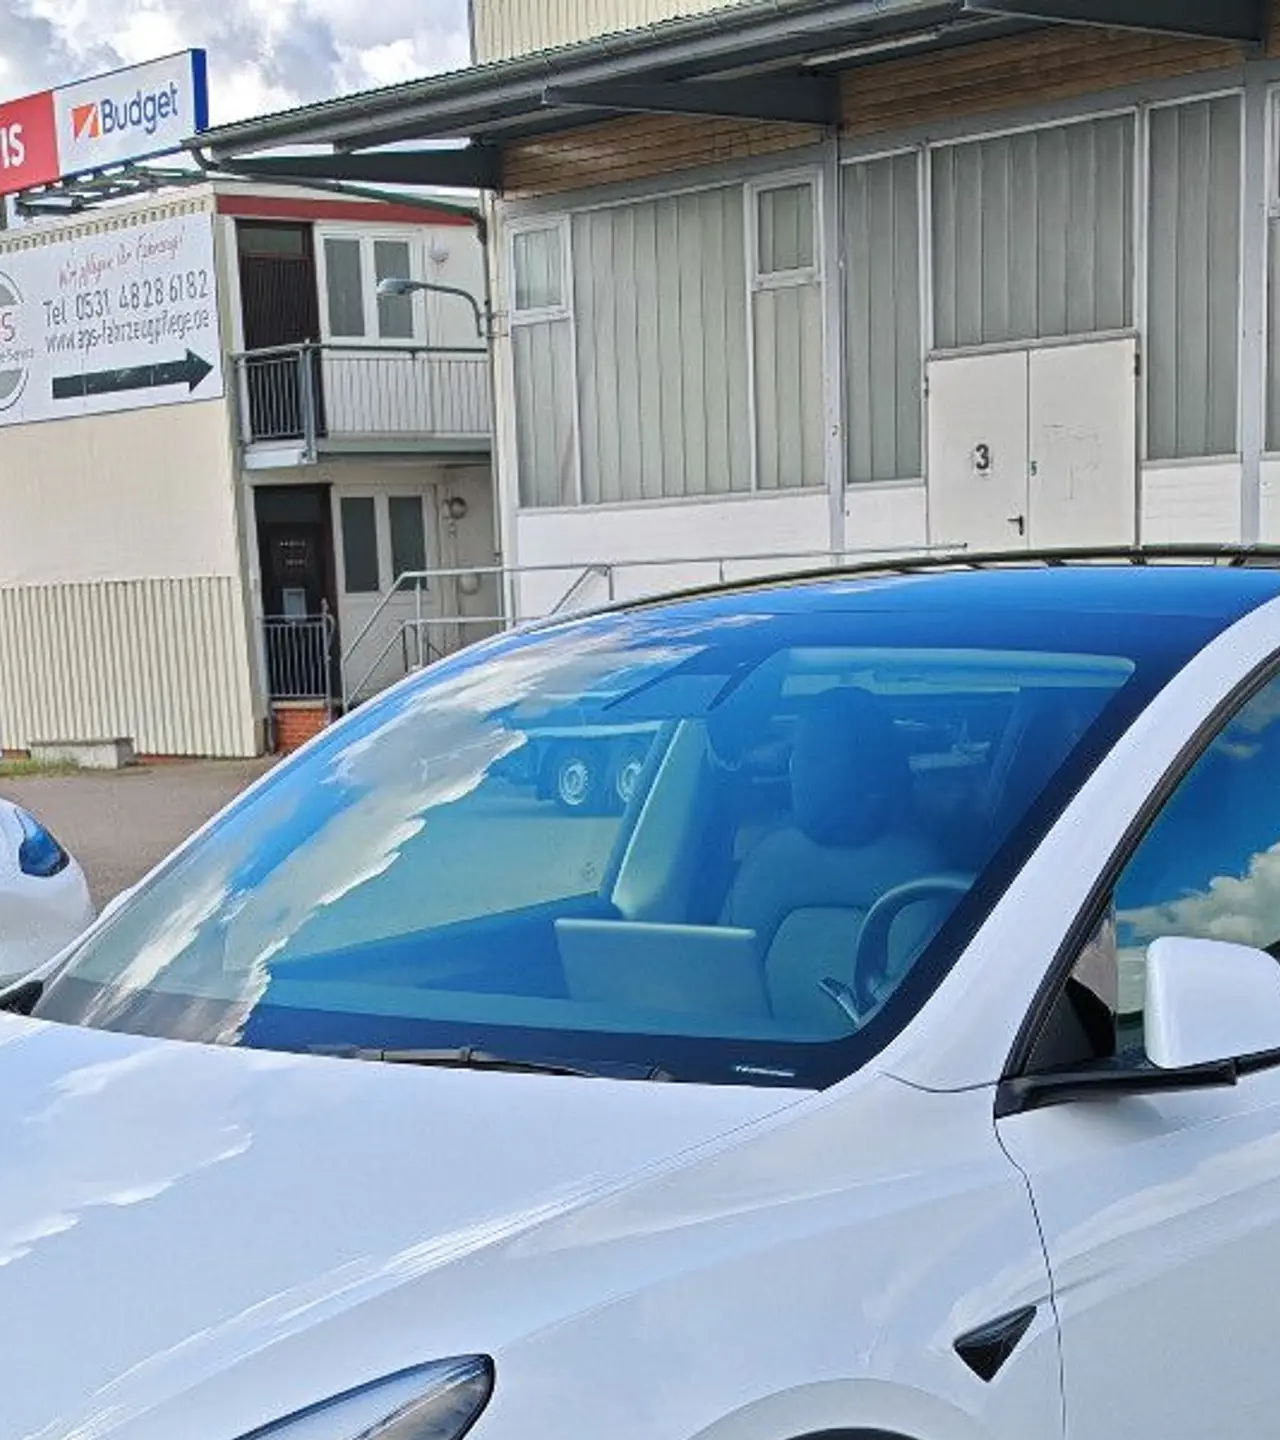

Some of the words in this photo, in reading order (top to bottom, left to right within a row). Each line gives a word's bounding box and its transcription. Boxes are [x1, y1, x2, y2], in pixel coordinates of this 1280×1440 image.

[101, 81, 178, 134] Budget
[76, 288, 110, 321] 0531
[975, 443, 990, 471] 3
